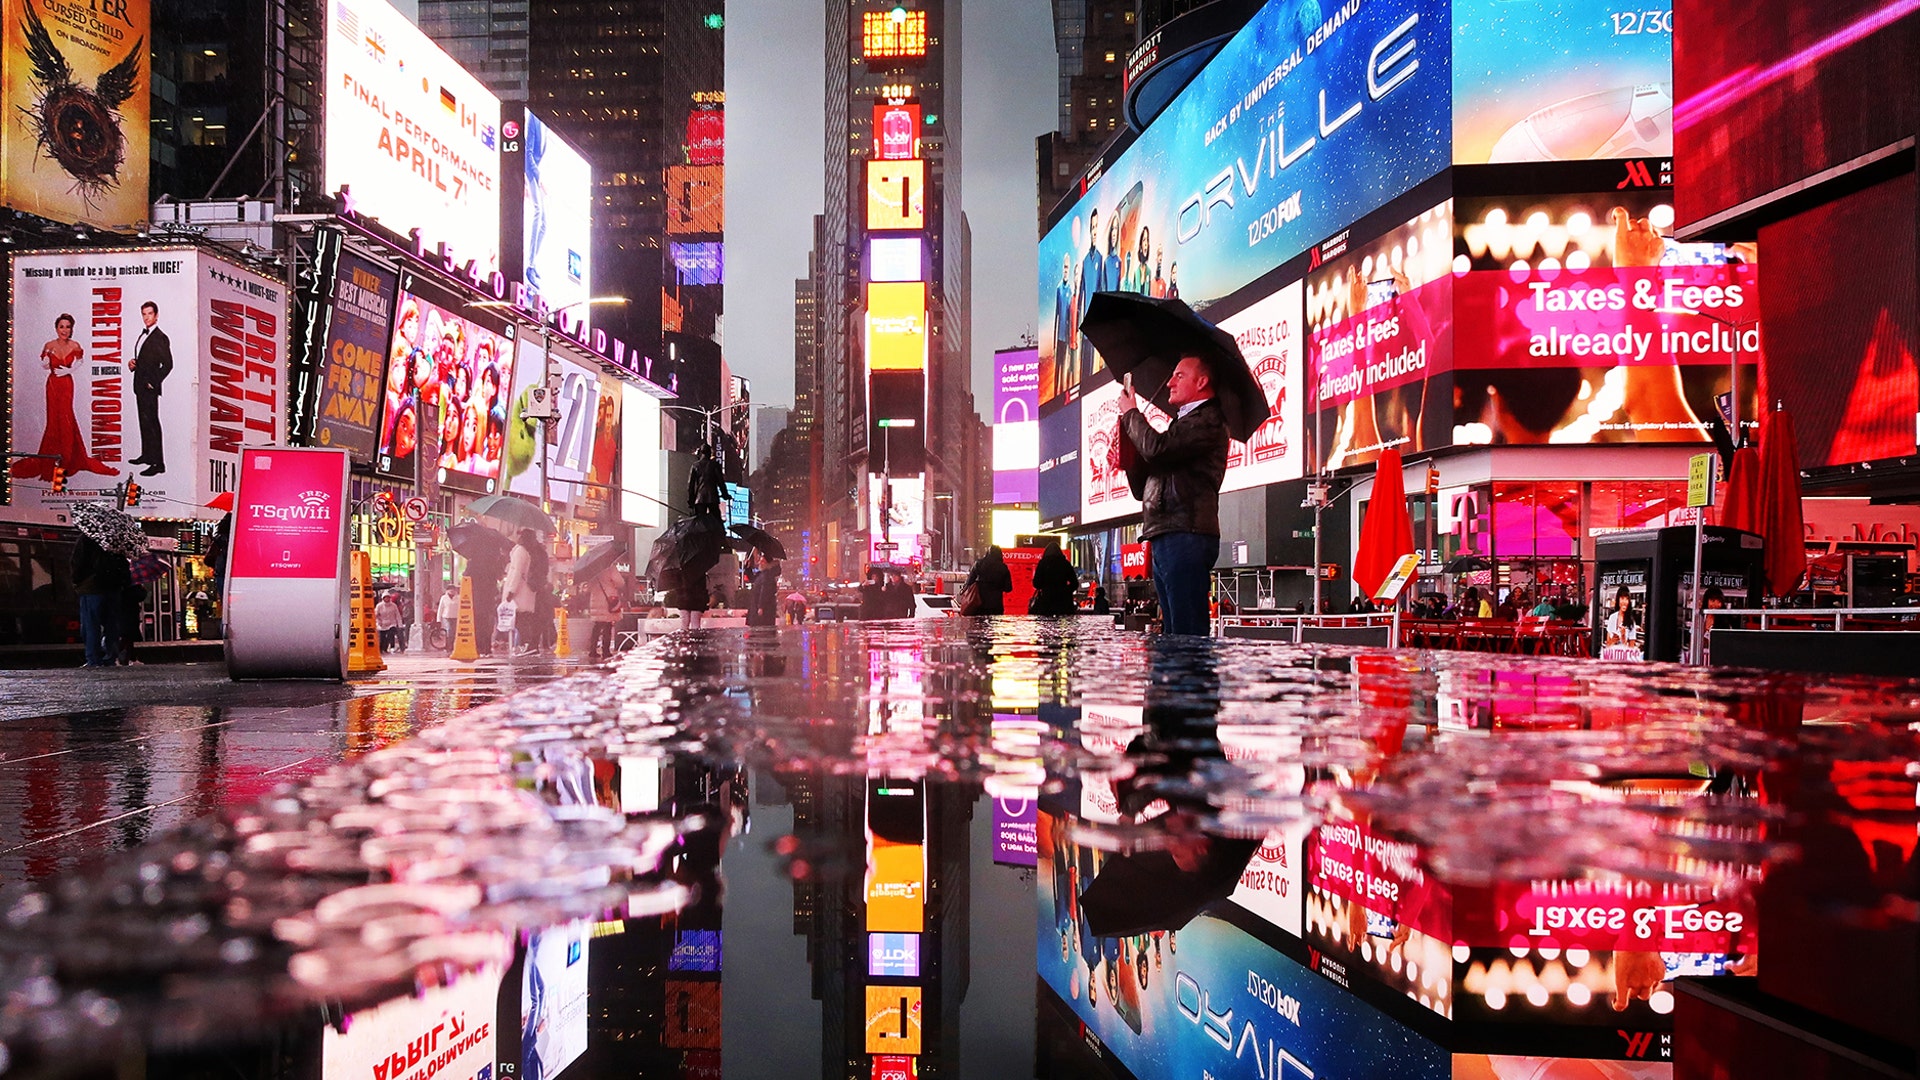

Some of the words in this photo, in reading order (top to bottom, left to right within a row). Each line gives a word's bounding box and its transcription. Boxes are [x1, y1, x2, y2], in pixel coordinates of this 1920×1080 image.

[43, 0, 87, 25] CURSED
[89, 18, 124, 41] CHILD
[55, 29, 69, 39] ON
[70, 35, 111, 57] BROADWAY
[1128, 31, 1162, 69] MARRIOTT
[1128, 49, 1158, 83] MARQUIS
[1204, 114, 1227, 147] BACK
[1229, 102, 1242, 127] BY
[1244, 52, 1303, 112] UNIVERSAL
[1306, 0, 1360, 55] DEMAND
[343, 73, 391, 120] FINAL
[394, 110, 492, 191] PERFORMANCE
[1175, 12, 1420, 245] ORVILLE
[1258, 100, 1286, 134] THE
[503, 141, 519, 152] LG
[377, 126, 447, 193] APRIL
[453, 175, 468, 206] 7!
[164, 222, 208, 234] LAMAR
[1247, 204, 1277, 247] 12/30
[1277, 190, 1303, 230] FOX
[55, 266, 62, 277] it
[64, 265, 86, 278] would
[88, 265, 96, 276] be
[98, 267, 104, 275] a
[105, 265, 117, 278] big
[339, 279, 359, 305] BEST
[408, 226, 505, 300] 1540
[510, 281, 653, 379] BROADWAY
[1529, 281, 1626, 312] Taxes
[1632, 279, 1656, 309] &
[1664, 278, 1743, 309] Fees
[91, 287, 122, 364] PRETTY
[1268, 327, 1274, 346] &
[1276, 320, 1291, 342] CO.
[1319, 331, 1355, 364] Taxes
[1355, 323, 1366, 349] &
[1367, 315, 1400, 346] Fees
[1529, 324, 1653, 361] already
[332, 339, 383, 377] COME
[1001, 363, 1008, 373] 6
[1008, 363, 1024, 372] new
[1253, 357, 1286, 379] IVETED
[1319, 366, 1364, 401] already
[1366, 339, 1426, 386] included
[210, 298, 245, 455] WOMAN
[245, 304, 277, 448] PRETT
[328, 363, 379, 403] FROM
[1001, 373, 1019, 384] sold
[91, 377, 122, 463] WOMAN
[323, 392, 377, 427] AWAY
[209, 459, 229, 493] THE
[250, 504, 331, 520] TSqWifi
[298, 490, 330, 500] FREE
[1602, 574, 1616, 585] SLICE
[1616, 574, 1623, 585] OF
[1683, 574, 1702, 585] SLIE
[1703, 576, 1712, 586] OF
